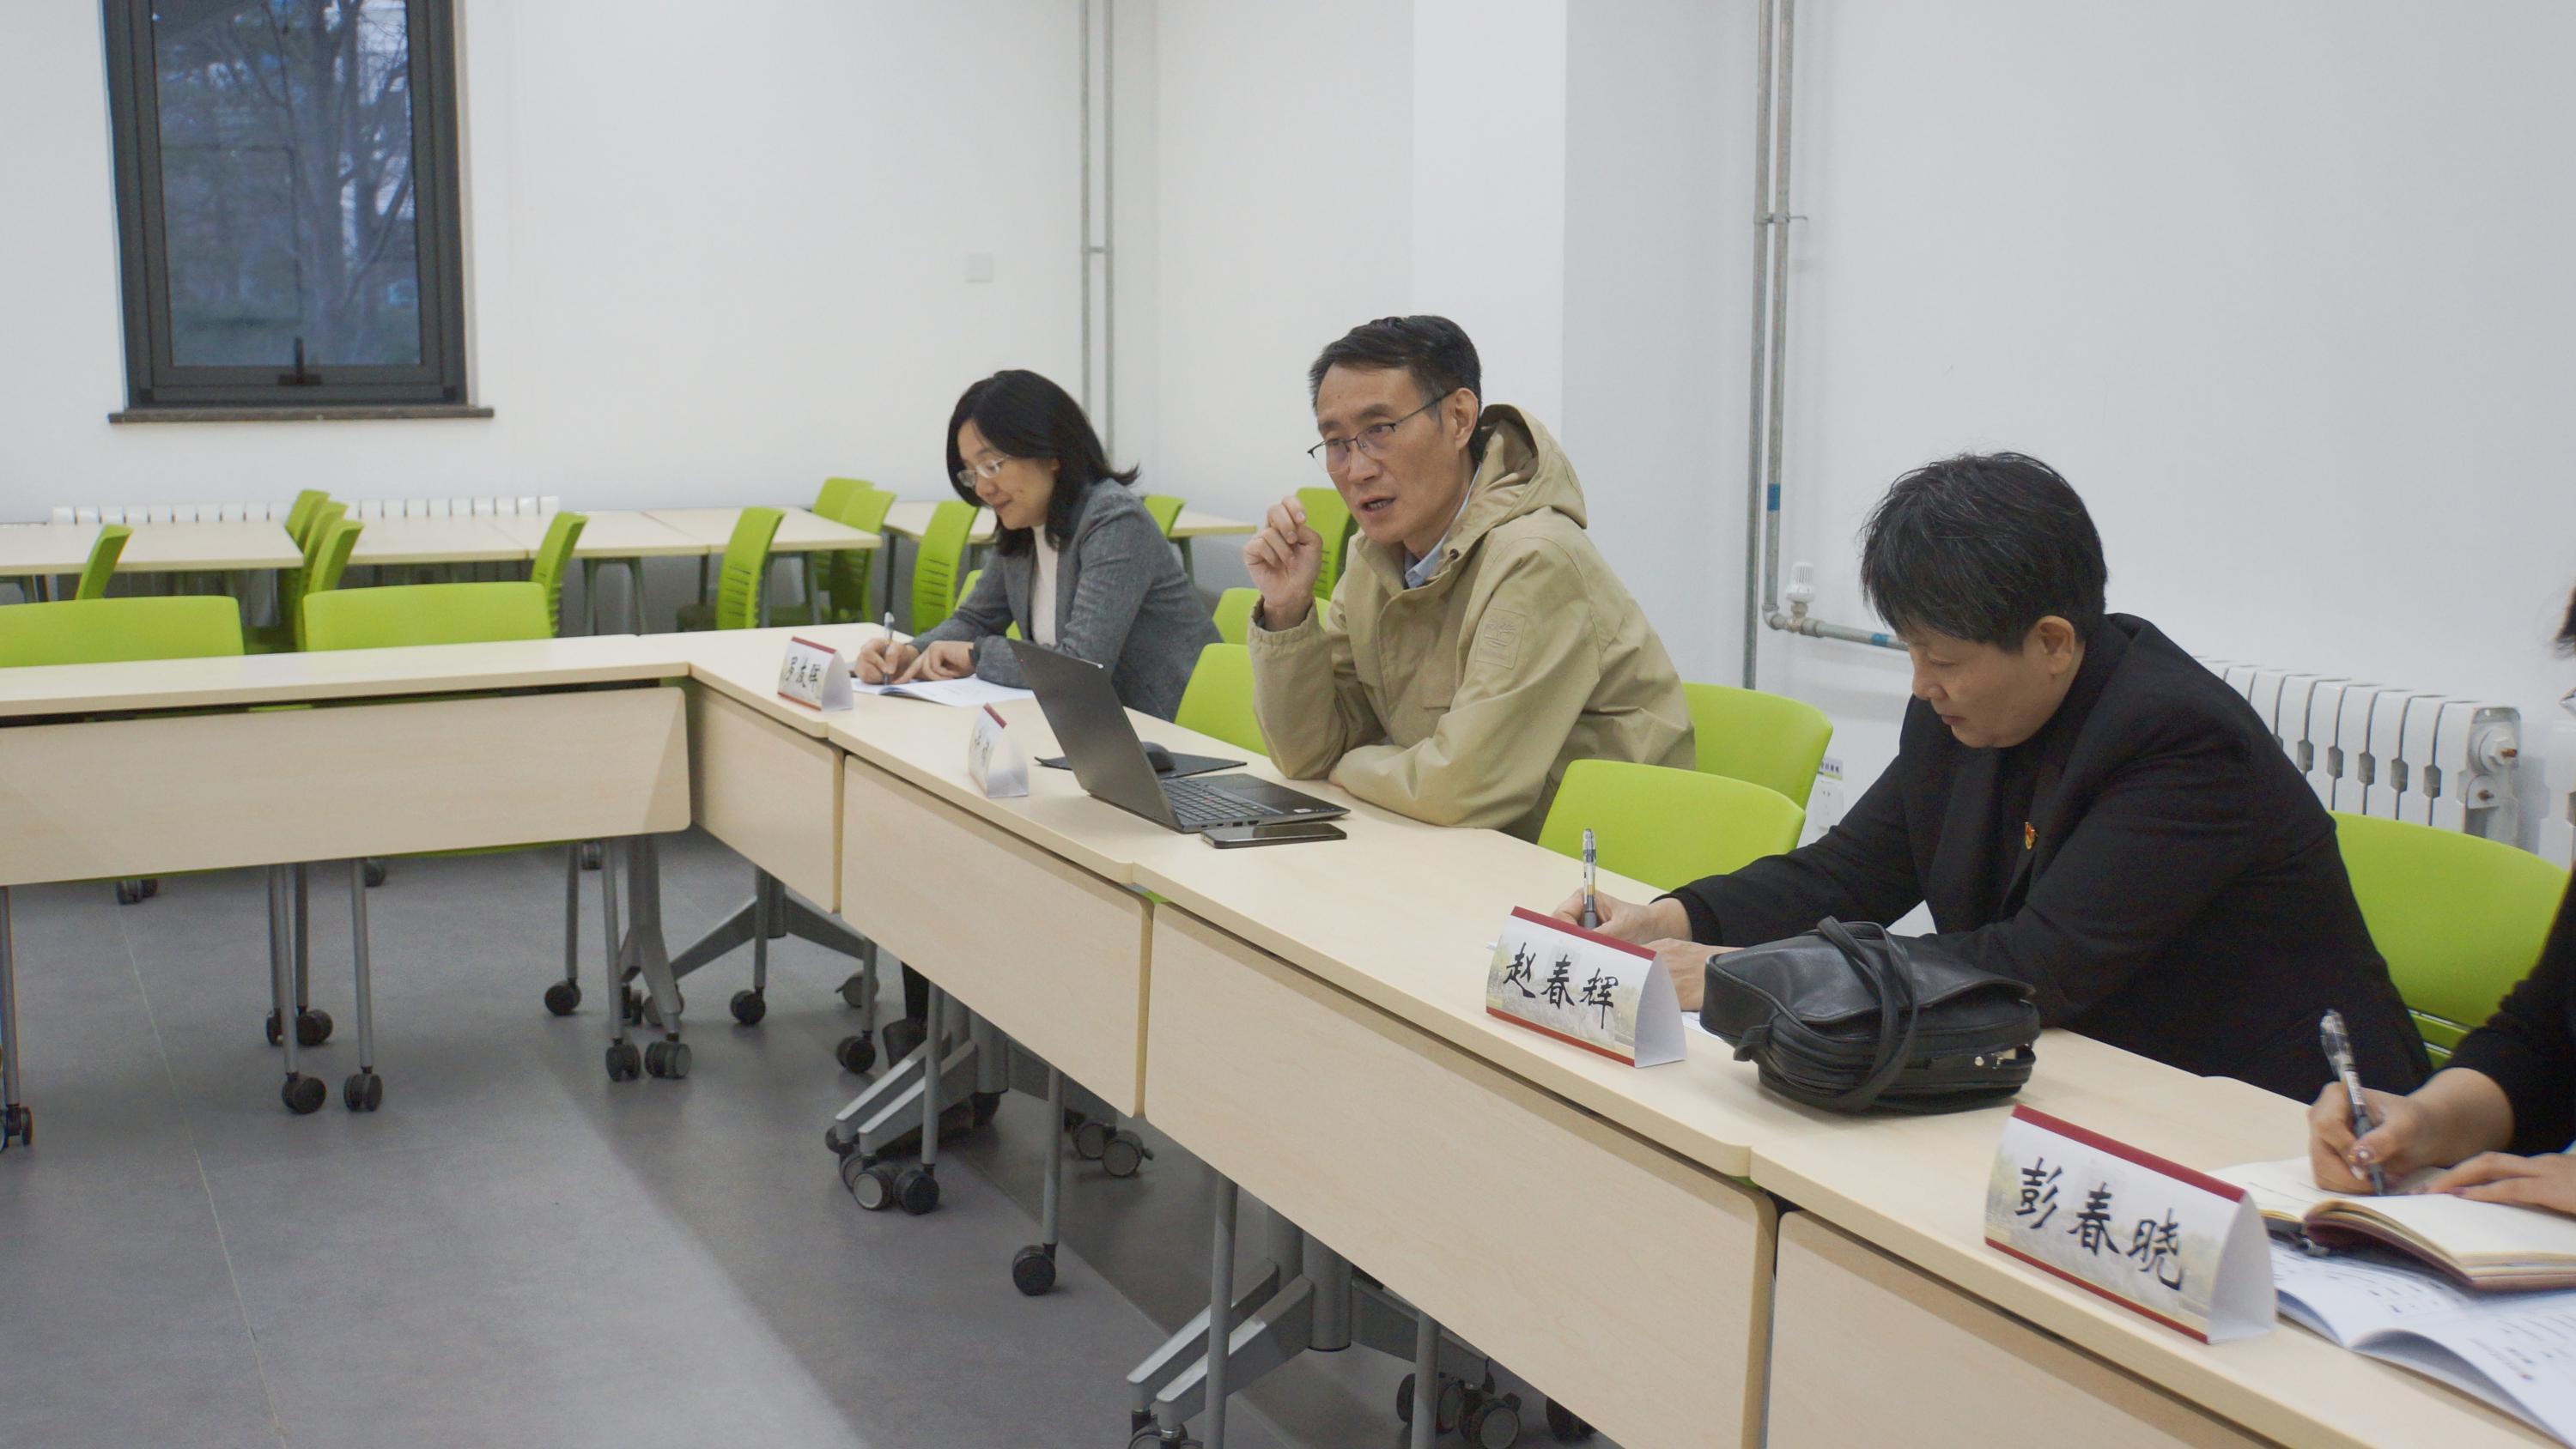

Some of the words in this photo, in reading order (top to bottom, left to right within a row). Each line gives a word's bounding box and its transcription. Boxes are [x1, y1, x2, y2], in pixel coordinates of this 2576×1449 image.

[1503, 942, 1619, 1029] 赵春辉
[2014, 1156, 2182, 1290] 彭春晓
